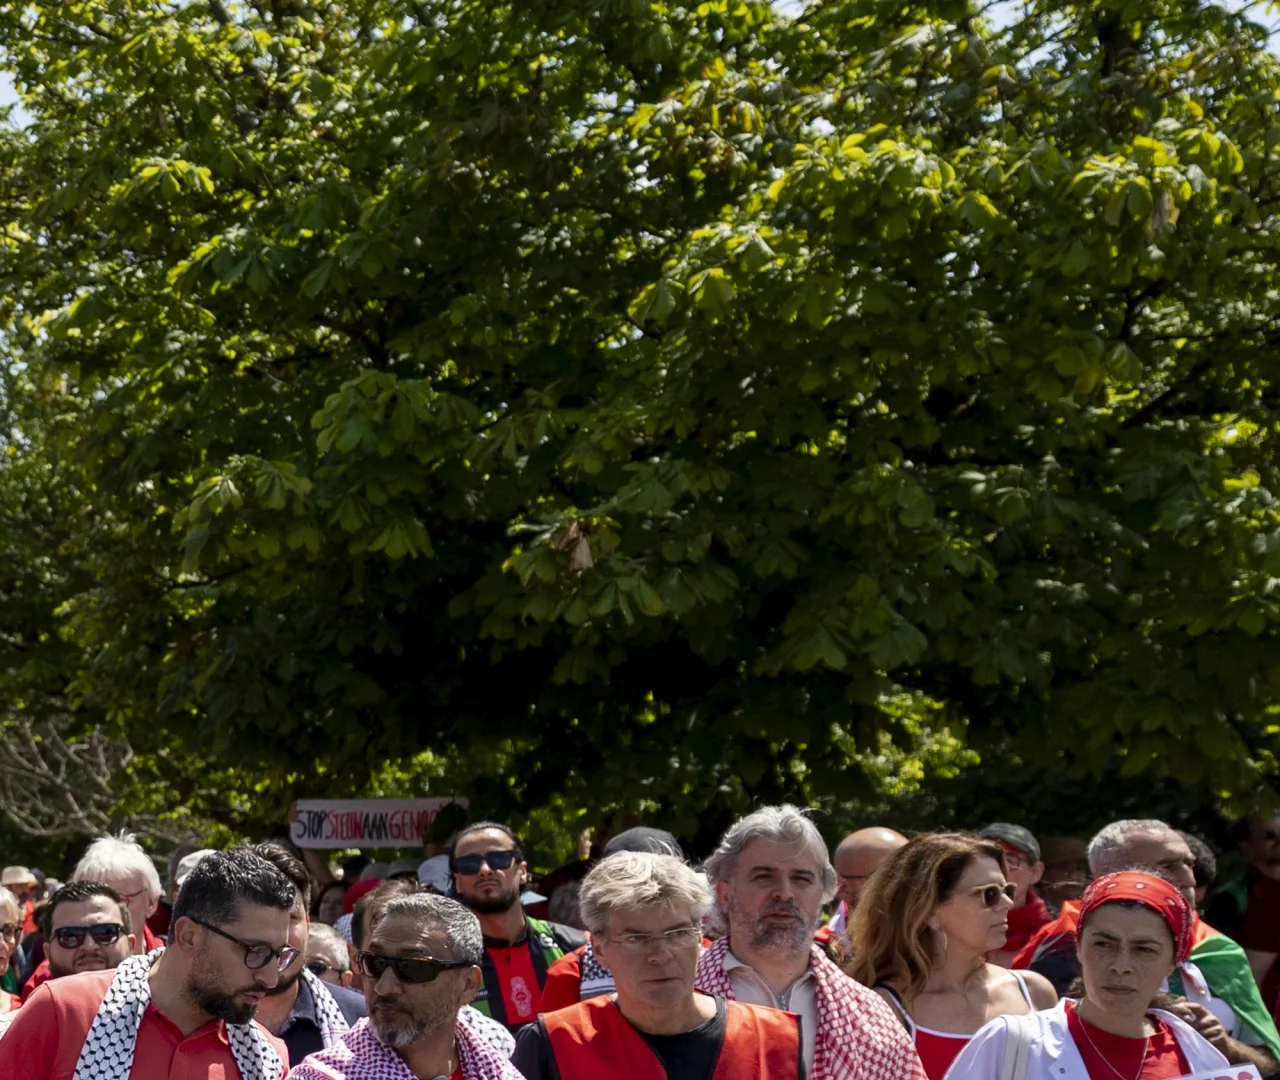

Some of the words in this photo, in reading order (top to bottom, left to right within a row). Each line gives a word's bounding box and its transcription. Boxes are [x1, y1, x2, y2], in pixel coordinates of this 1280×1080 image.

[296, 809, 325, 840] STOP
[324, 810, 363, 841] STEUN
[363, 813, 389, 841] AAN
